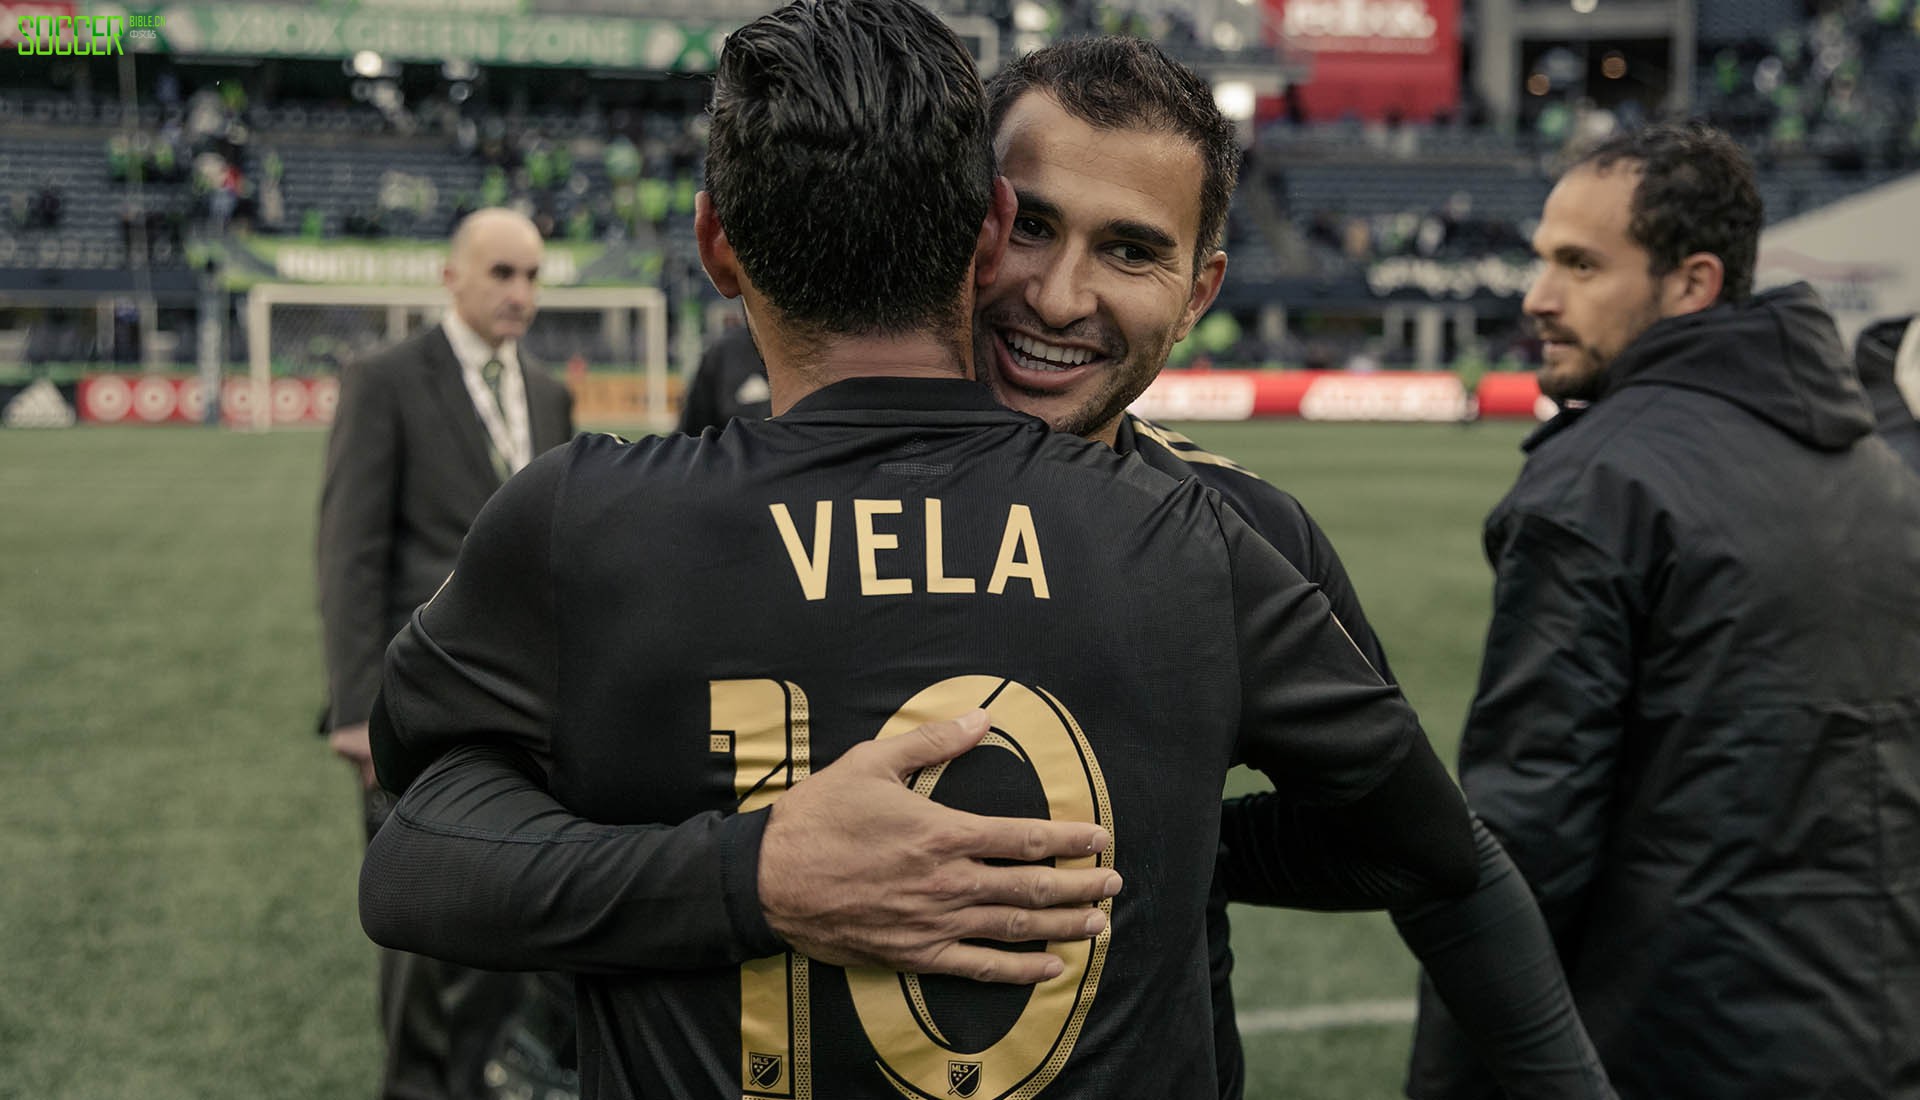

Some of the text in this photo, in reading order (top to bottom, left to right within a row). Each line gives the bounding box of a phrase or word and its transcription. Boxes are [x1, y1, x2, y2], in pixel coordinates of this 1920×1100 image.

[768, 497, 1051, 601] VELA
[709, 674, 1116, 1100] 10
[752, 1056, 769, 1066] MLS
[951, 1063, 969, 1073] MLS
